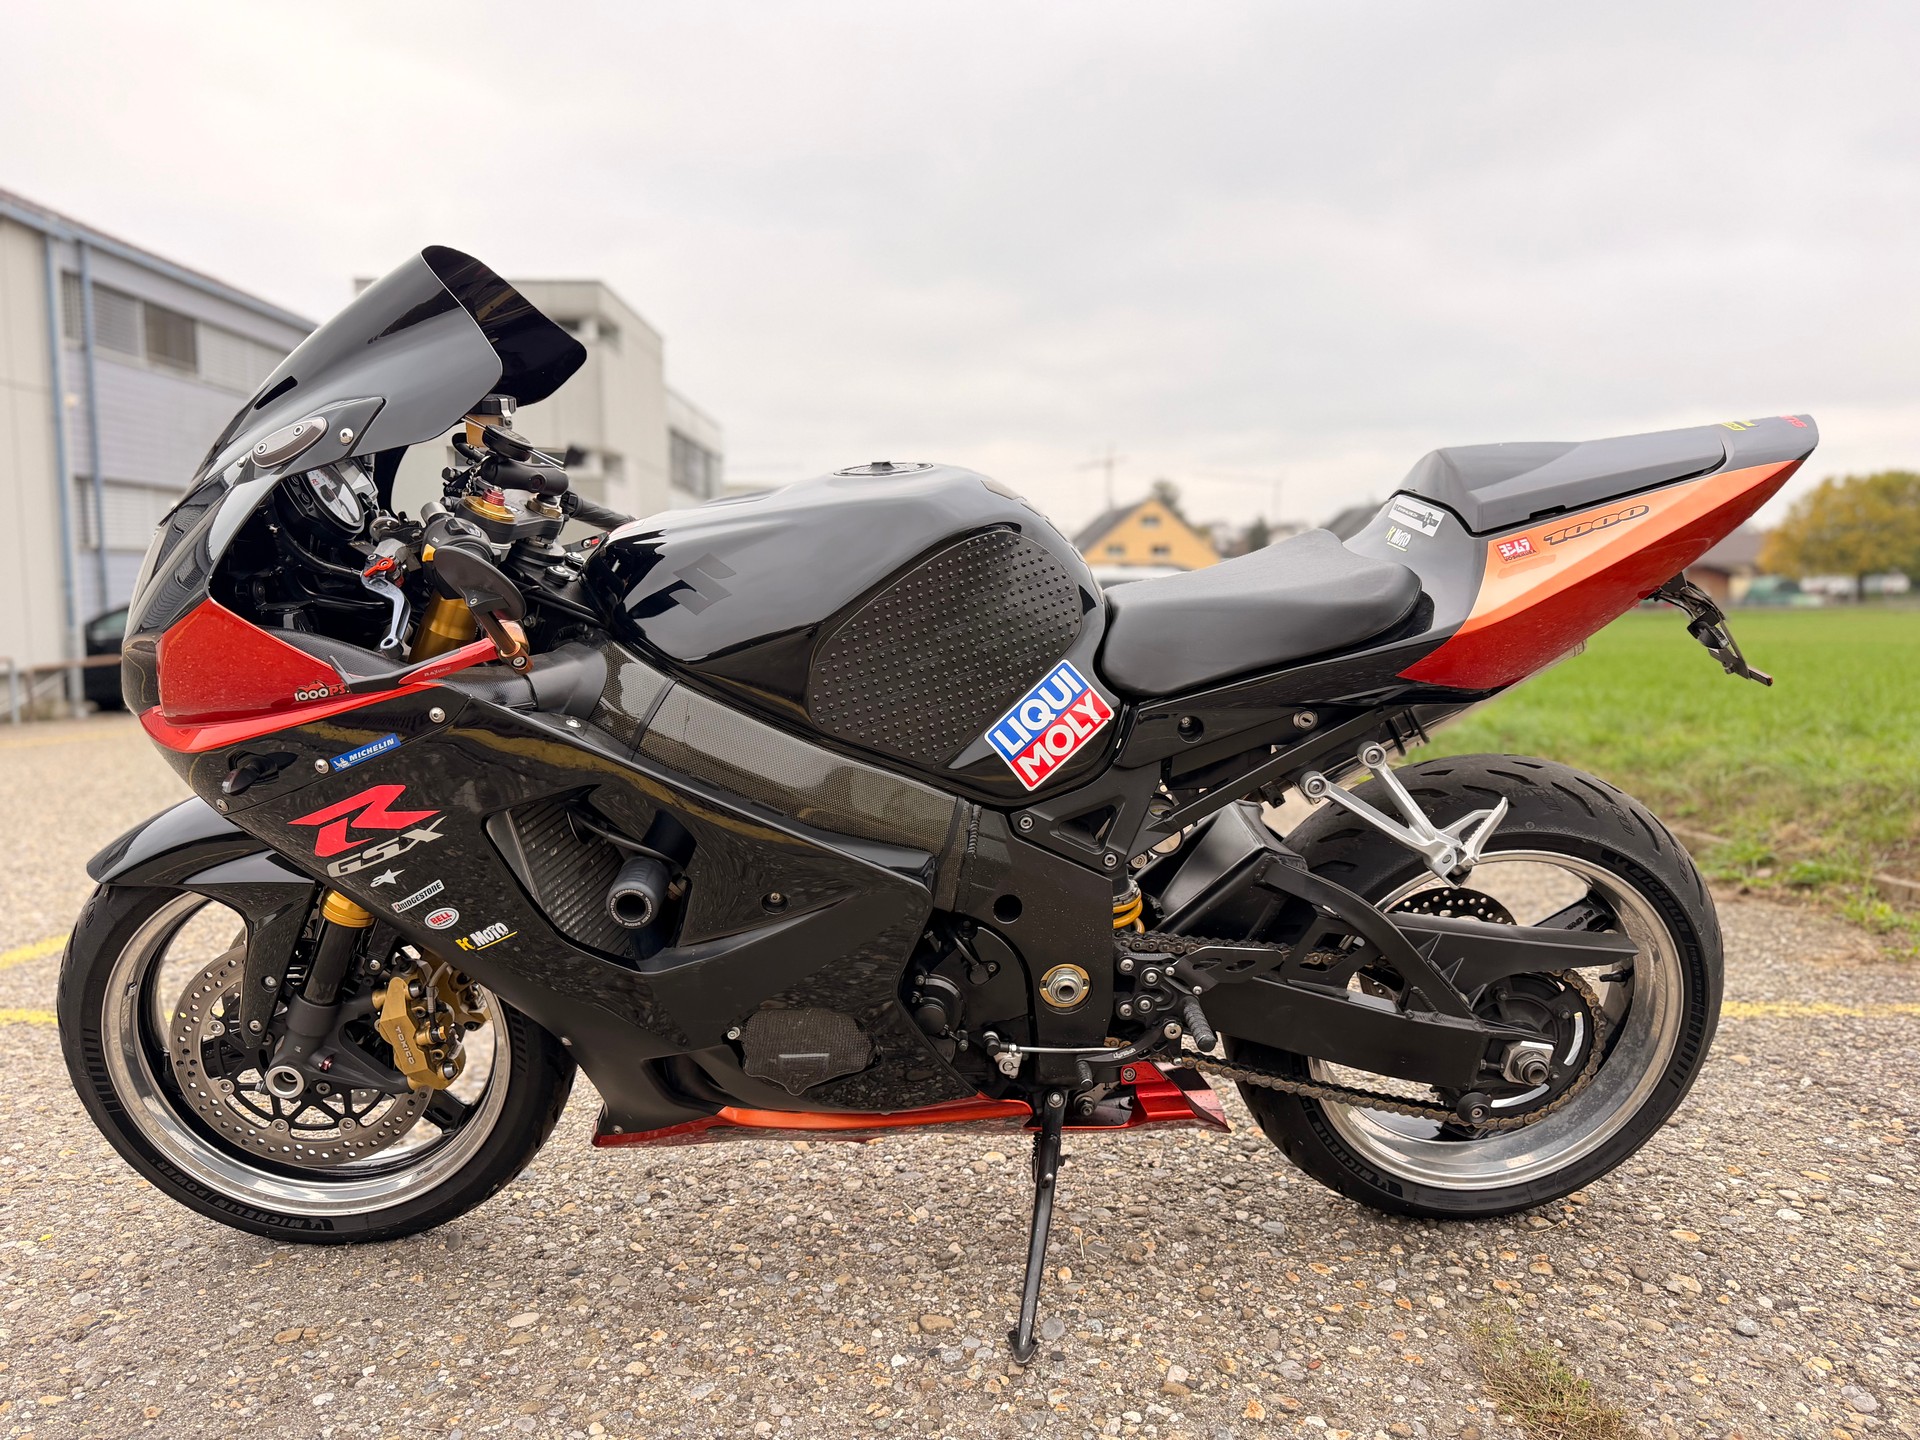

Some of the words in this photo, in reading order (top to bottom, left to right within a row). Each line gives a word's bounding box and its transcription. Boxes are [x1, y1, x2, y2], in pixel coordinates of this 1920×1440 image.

[1543, 505, 1650, 545] 1000
[993, 668, 1082, 756] LIQUI
[348, 738, 394, 761] MICHELIN
[1017, 694, 1104, 782] MOLY
[287, 784, 441, 857] R
[326, 815, 448, 878] GSX
[394, 881, 442, 912] BRIDGESTONE
[1628, 865, 1690, 933] MICHELIN
[430, 911, 453, 925] BELL
[469, 922, 510, 947] MOTO
[395, 1025, 415, 1065] TOKICO
[1313, 1121, 1375, 1180] MICHELIN
[214, 1199, 305, 1228] MICHELIN
